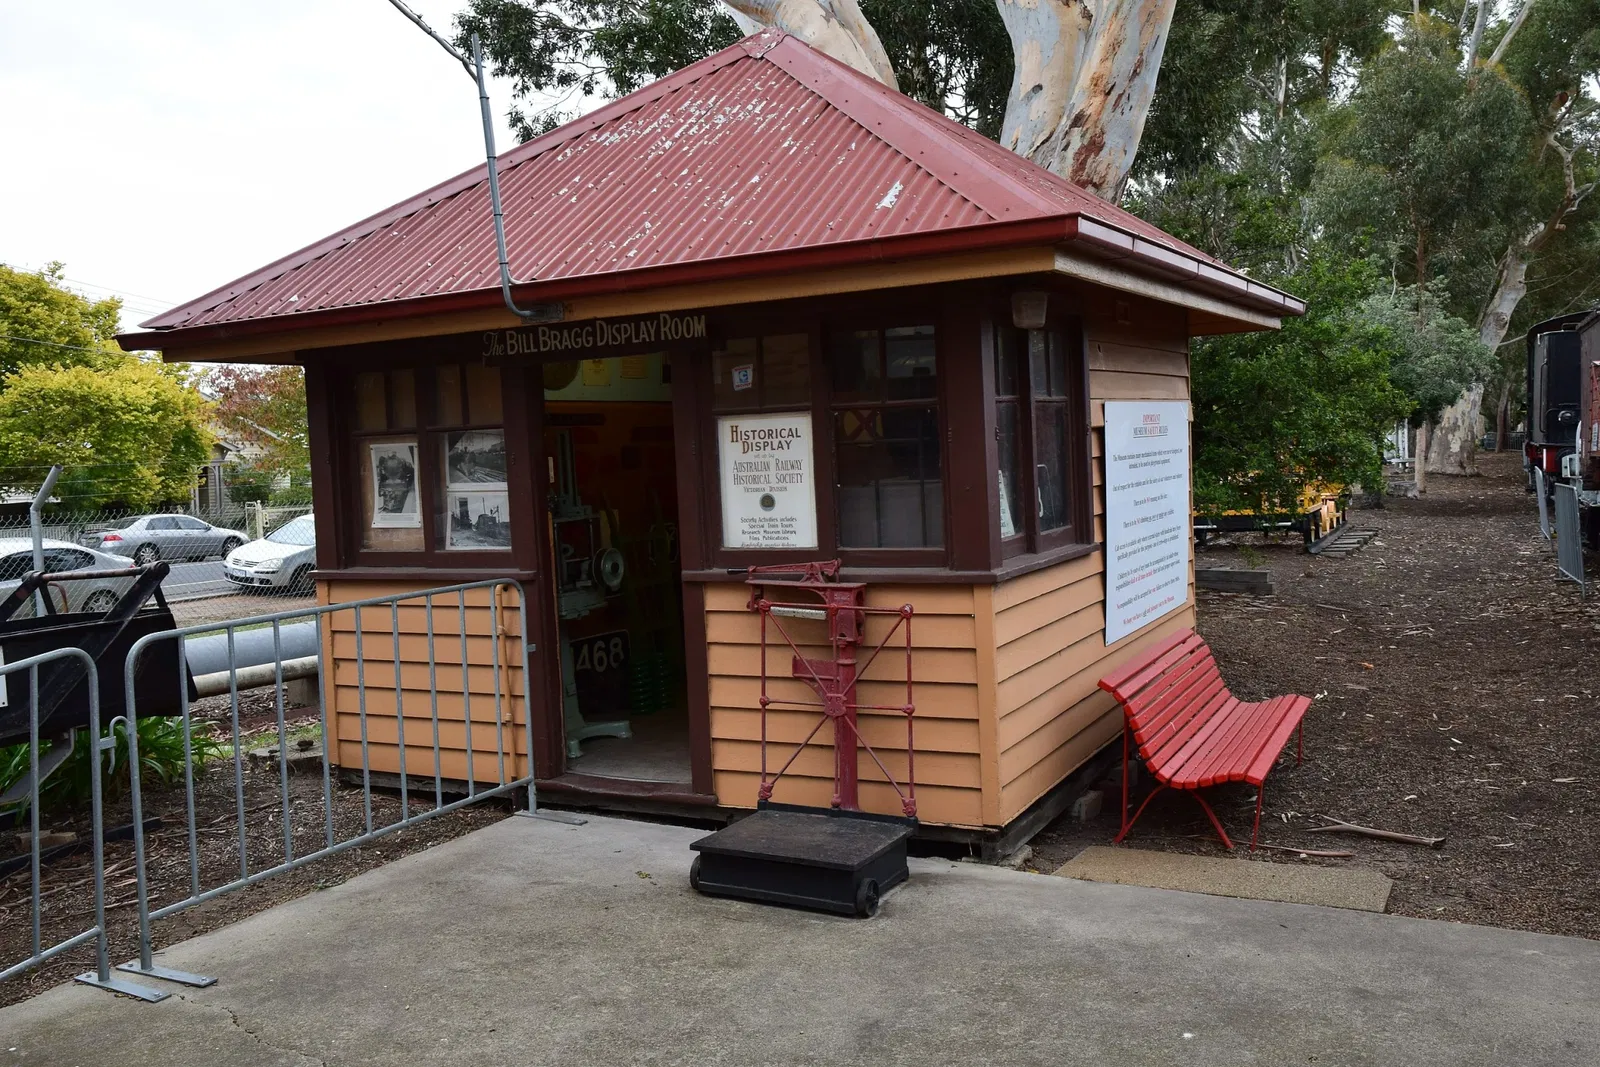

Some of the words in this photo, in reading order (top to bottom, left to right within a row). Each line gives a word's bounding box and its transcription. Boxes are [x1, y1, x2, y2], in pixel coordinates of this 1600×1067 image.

[482, 332, 505, 356] The
[506, 331, 538, 355] BILL
[539, 327, 594, 353] BRAGG
[595, 319, 657, 347] DISPLAY
[659, 313, 707, 340] ROOM
[730, 425, 802, 443] HISTORICAL
[742, 440, 793, 454] DISPLAY
[732, 460, 771, 473] AUSTRALIAN
[775, 458, 804, 472] RAILWAY
[733, 473, 772, 486] HISTORICAL
[775, 472, 804, 484] SOCIETY
